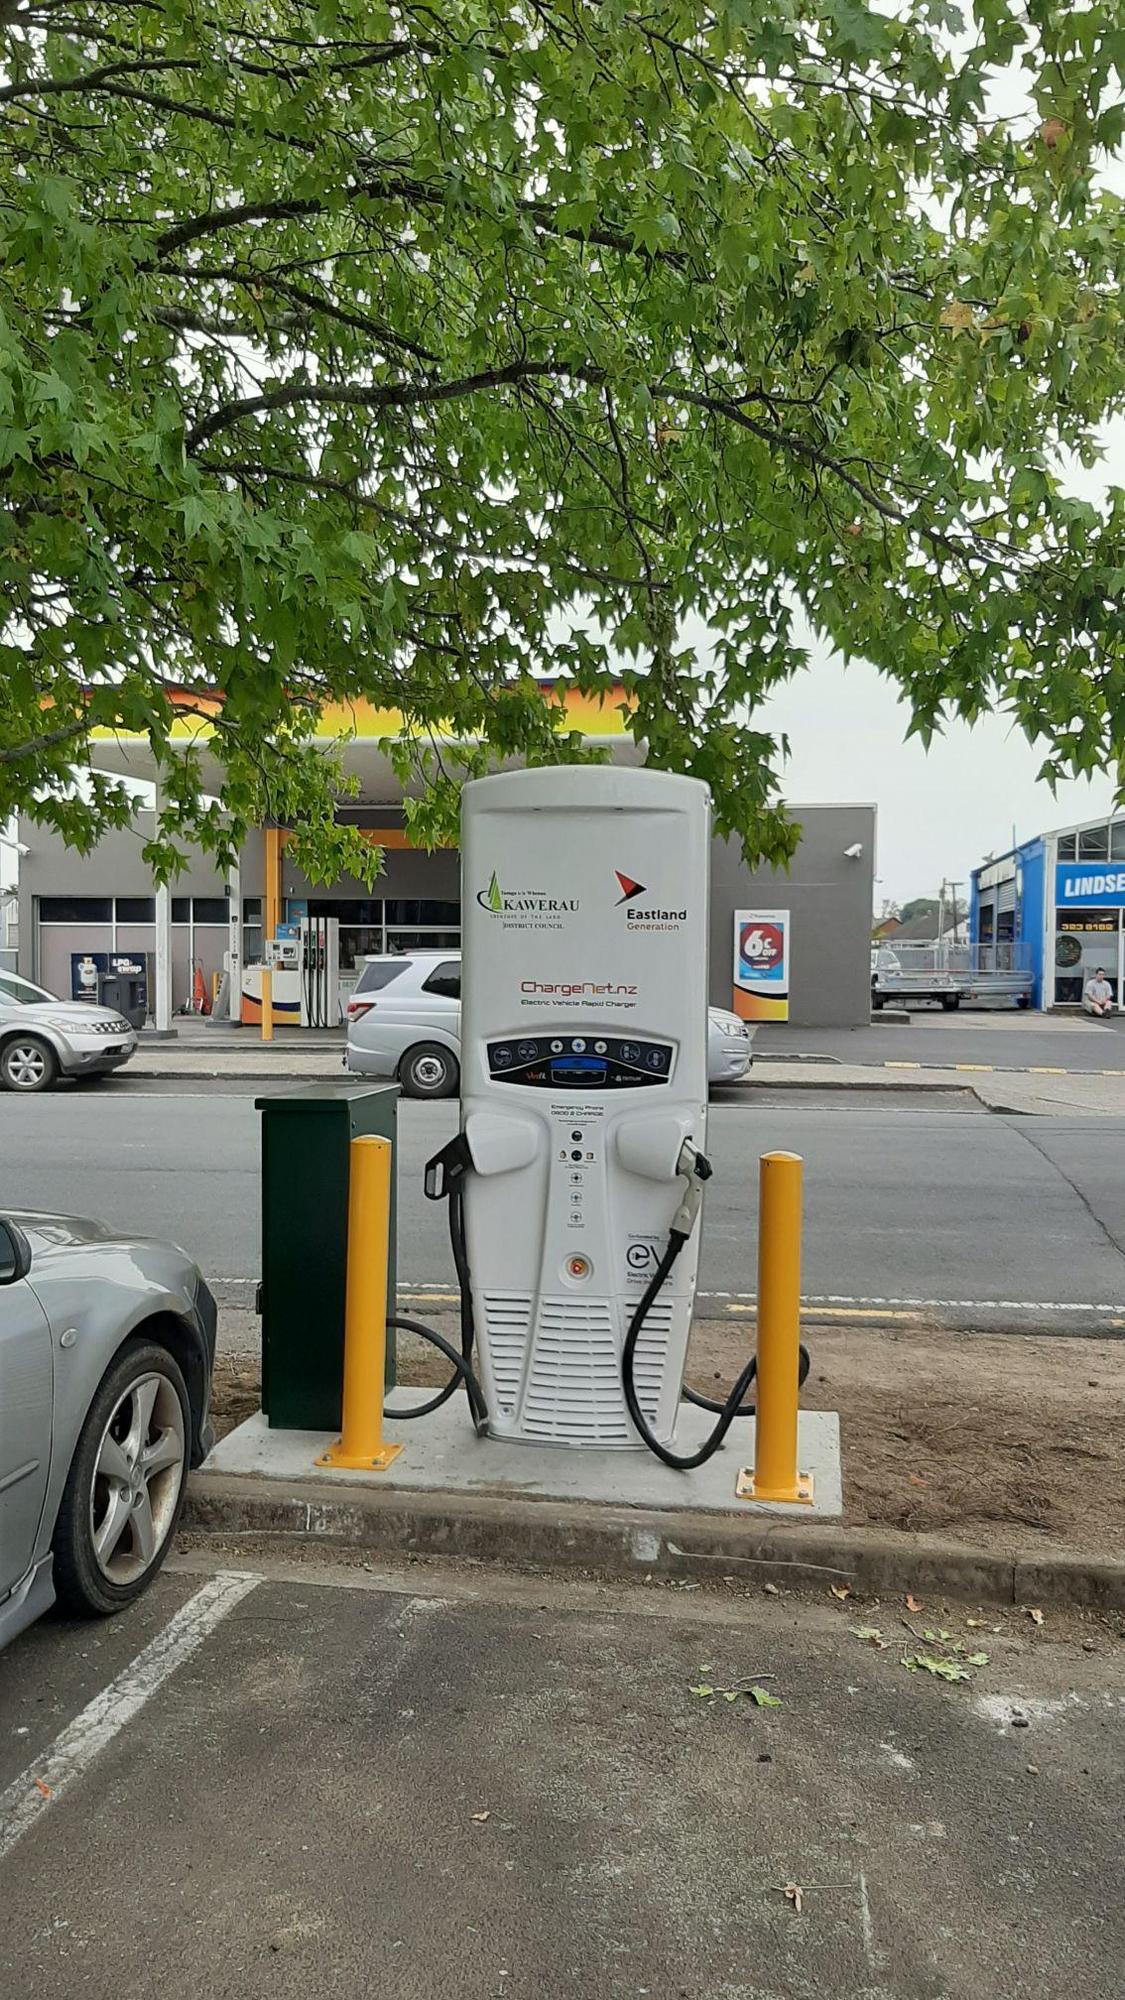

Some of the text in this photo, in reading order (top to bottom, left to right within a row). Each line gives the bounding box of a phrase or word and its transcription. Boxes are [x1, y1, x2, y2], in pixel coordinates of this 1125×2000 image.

[1064, 873, 1125, 898] LINDSE
[503, 899, 580, 912] KAWERAU
[627, 909, 687, 920] Eastland
[503, 922, 533, 930] DISTRICT
[627, 922, 680, 931] Generation
[581, 1000, 604, 1008] Rapid
[605, 1001, 637, 1009] Charger
